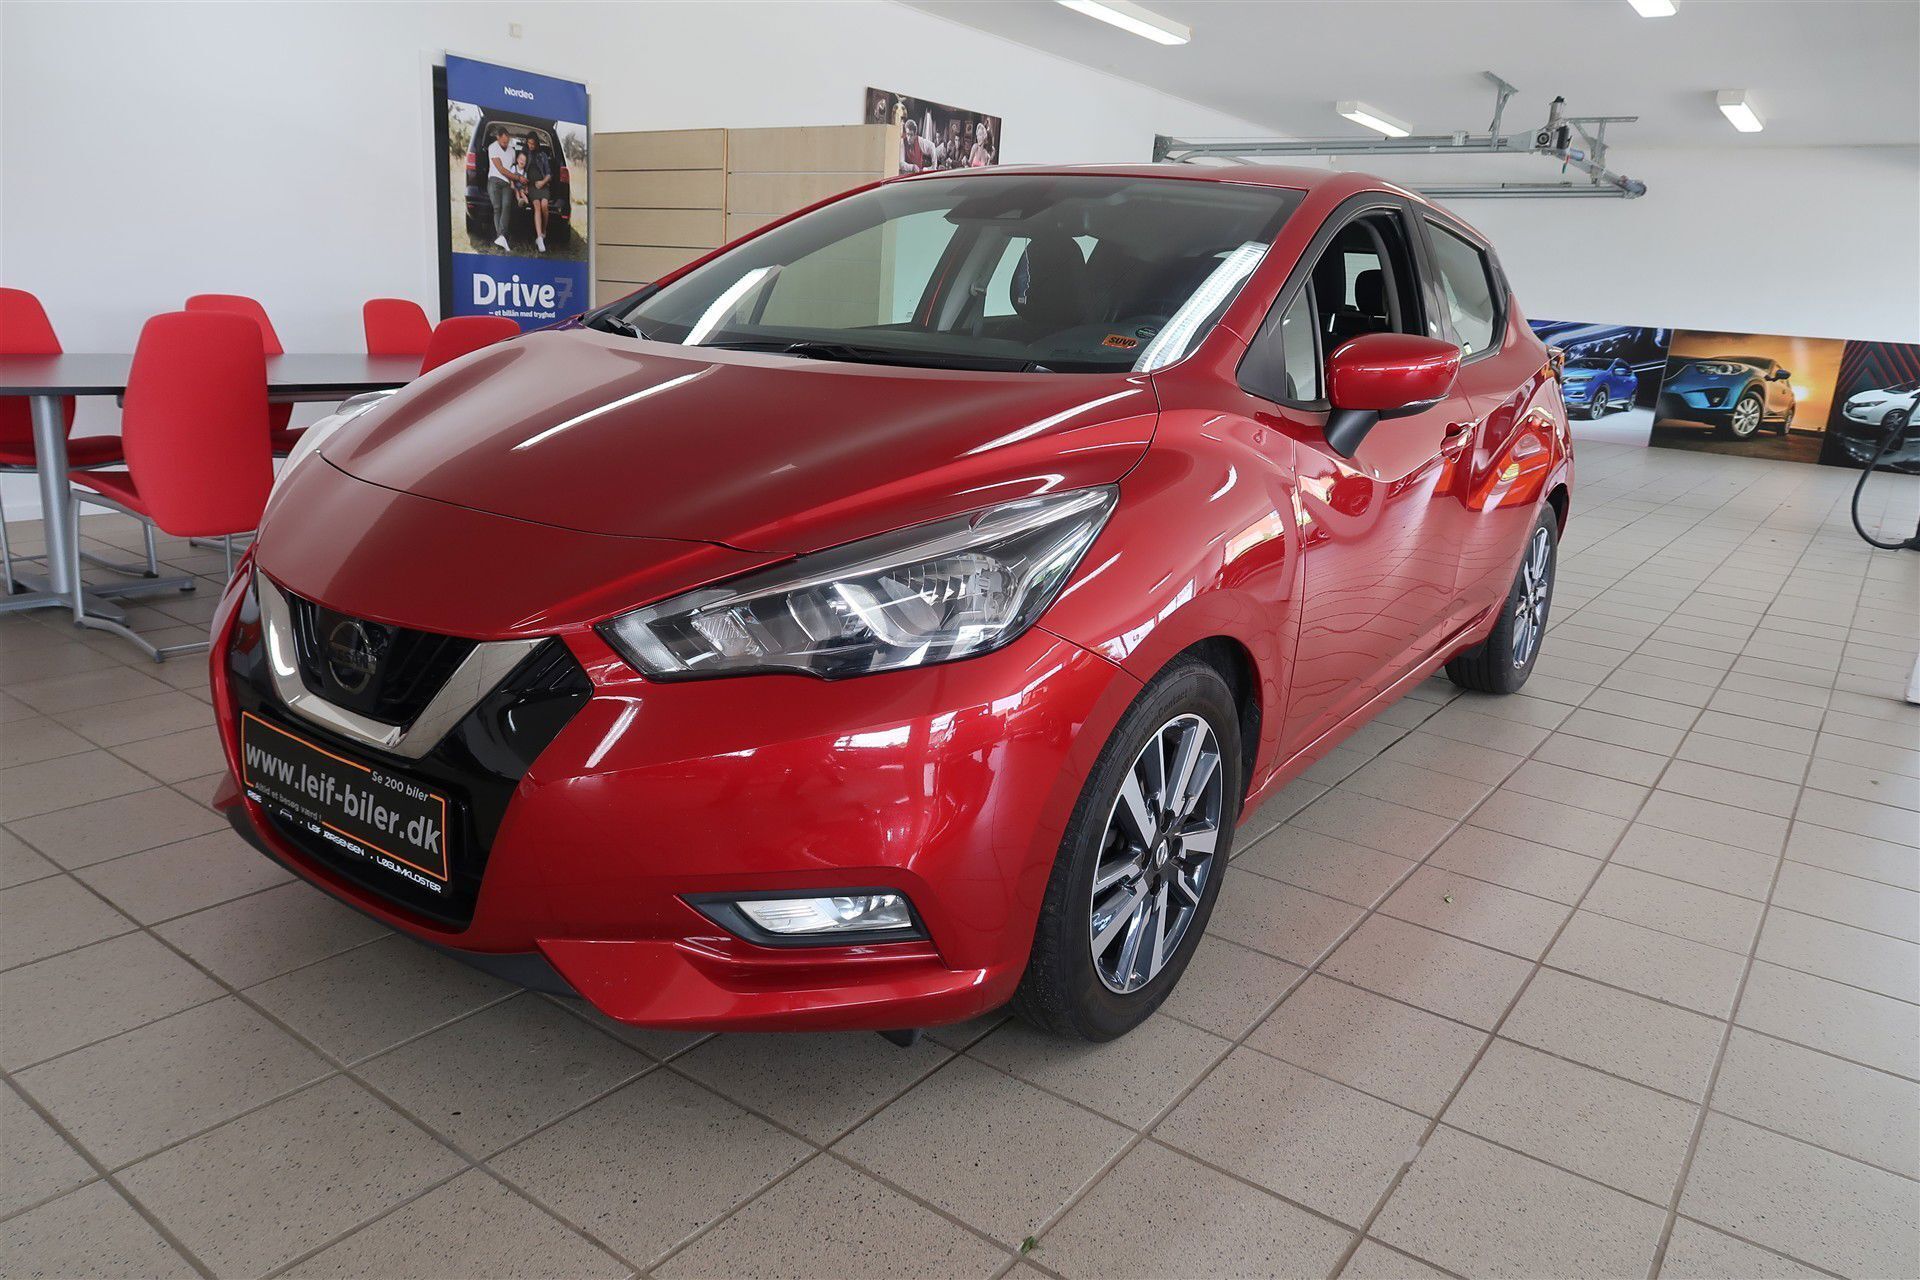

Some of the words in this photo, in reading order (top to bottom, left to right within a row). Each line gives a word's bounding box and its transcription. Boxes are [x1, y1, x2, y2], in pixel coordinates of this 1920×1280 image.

[504, 86, 534, 100] Nordea
[502, 309, 519, 317] billån
[533, 311, 556, 319] tryghed
[371, 770, 383, 784] Se
[384, 776, 404, 793] 200
[406, 784, 429, 802] biler
[245, 743, 442, 854] www.leif-biler.dk
